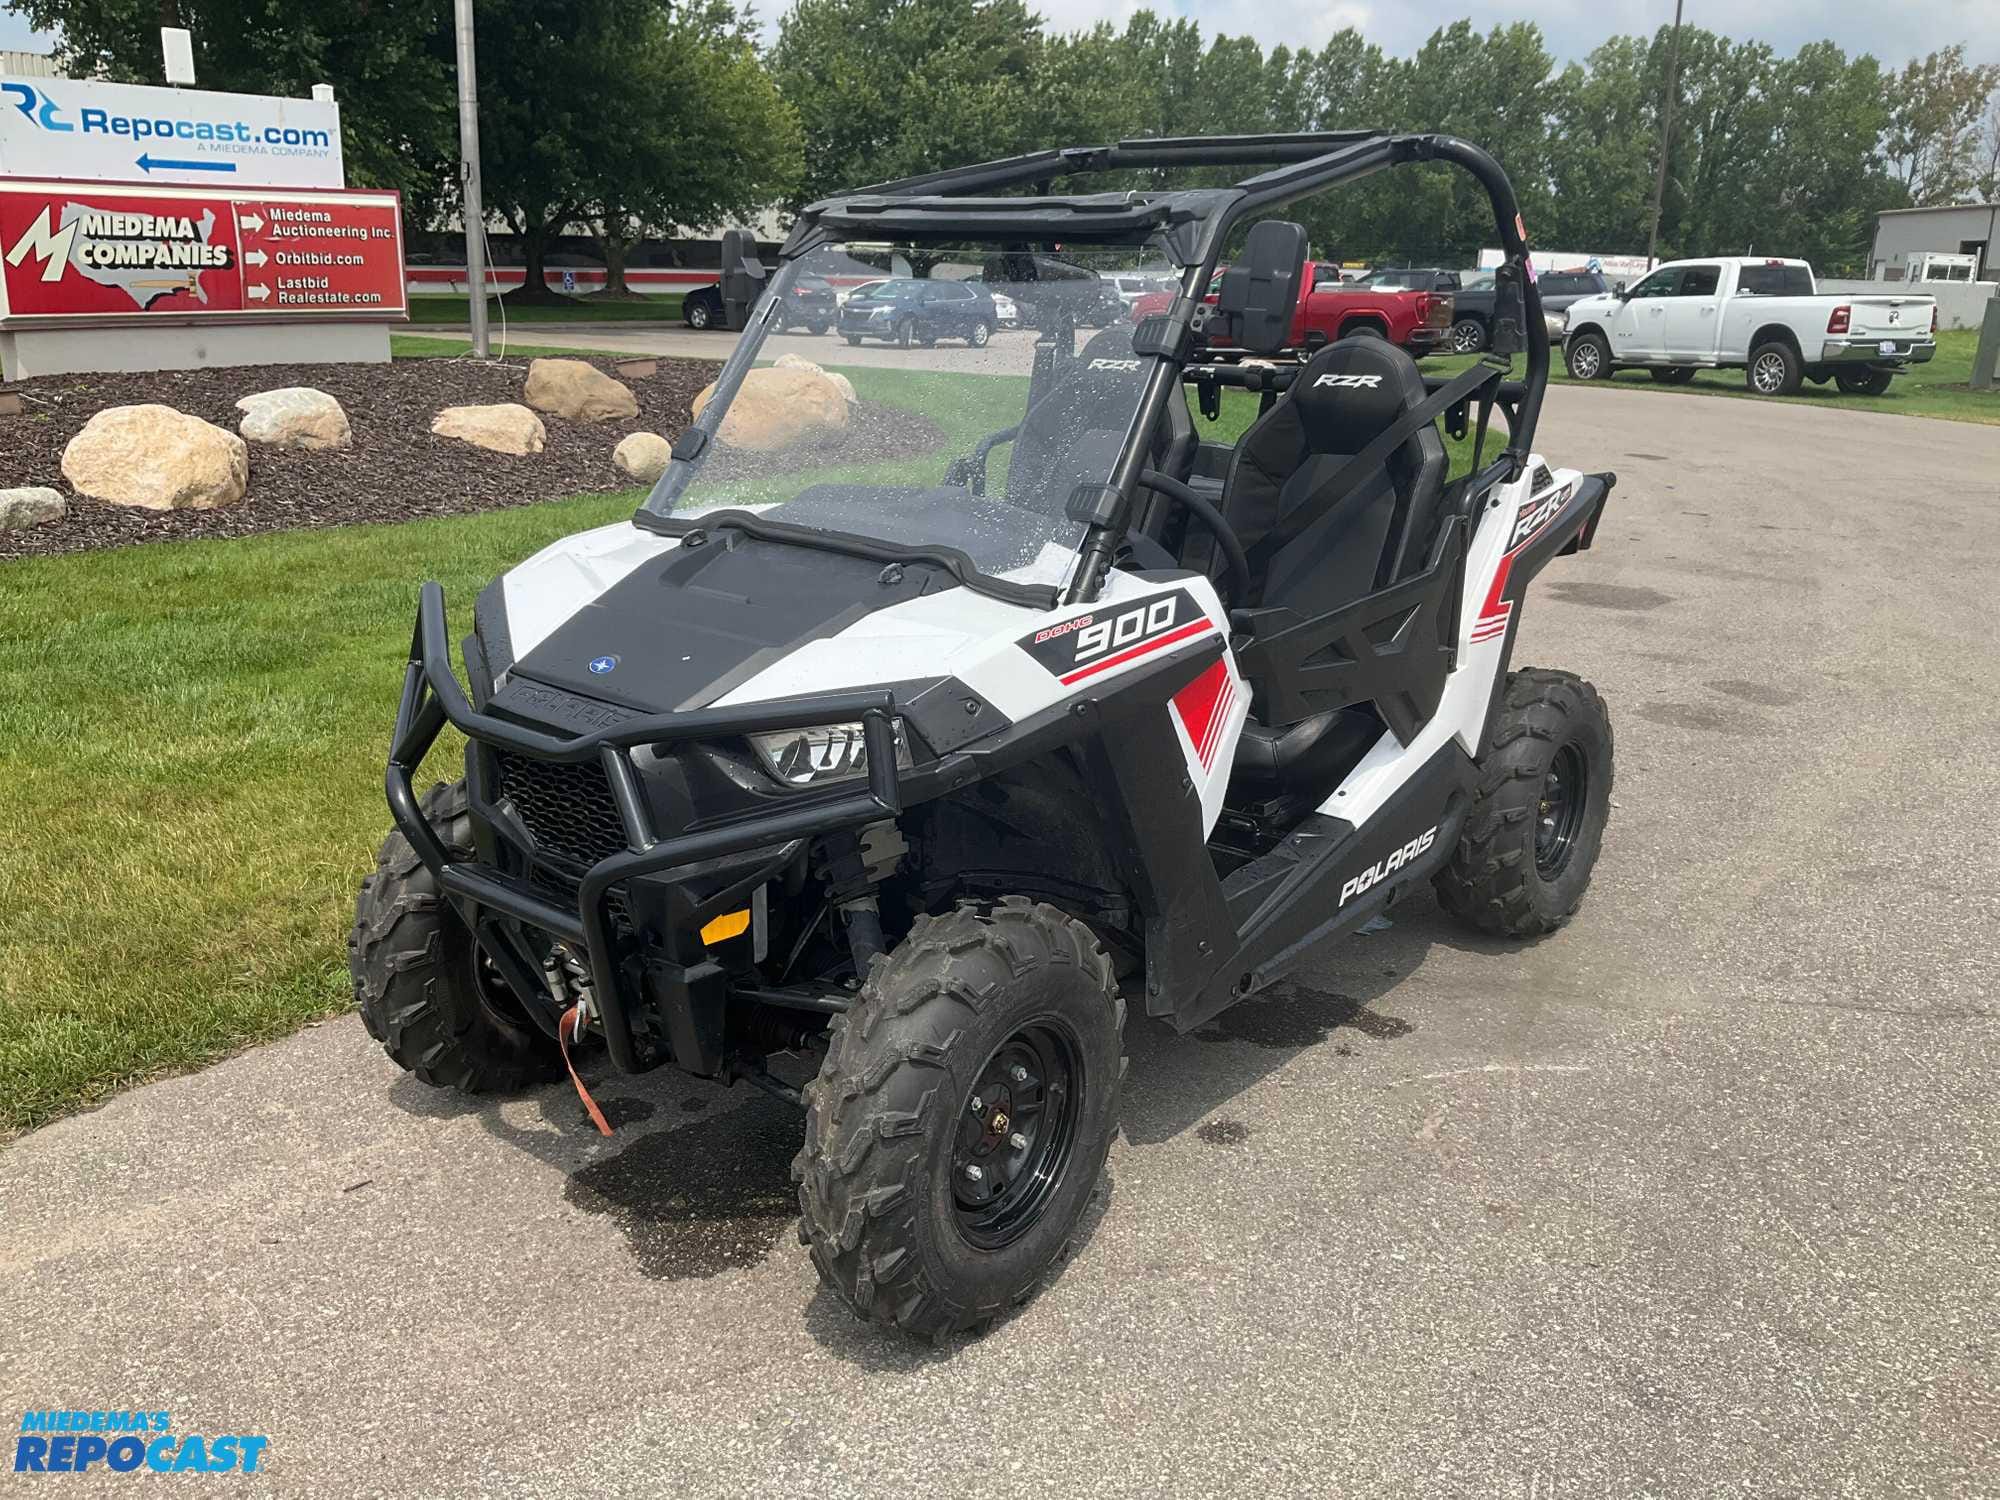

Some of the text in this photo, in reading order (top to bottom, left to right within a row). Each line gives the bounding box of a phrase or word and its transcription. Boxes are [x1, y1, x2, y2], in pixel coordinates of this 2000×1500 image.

[81, 108, 329, 147] Repocast.com
[197, 143, 329, 158] A MIEDEMA COMPANY
[269, 208, 332, 223] Miedema
[81, 214, 195, 239] MIEDEMA
[272, 224, 368, 240] Auctioneering
[78, 242, 228, 266] COMPANIES
[275, 252, 364, 265] Orbitbid.com
[277, 276, 329, 289] Lastbid
[278, 292, 381, 304] Realestate.com
[1087, 358, 1140, 371] RZR
[1312, 374, 1383, 389] RZR
[1510, 490, 1561, 547] RZR
[1034, 615, 1094, 644] DOHC
[1074, 596, 1176, 662] 900
[1338, 825, 1437, 907] POLARIS
